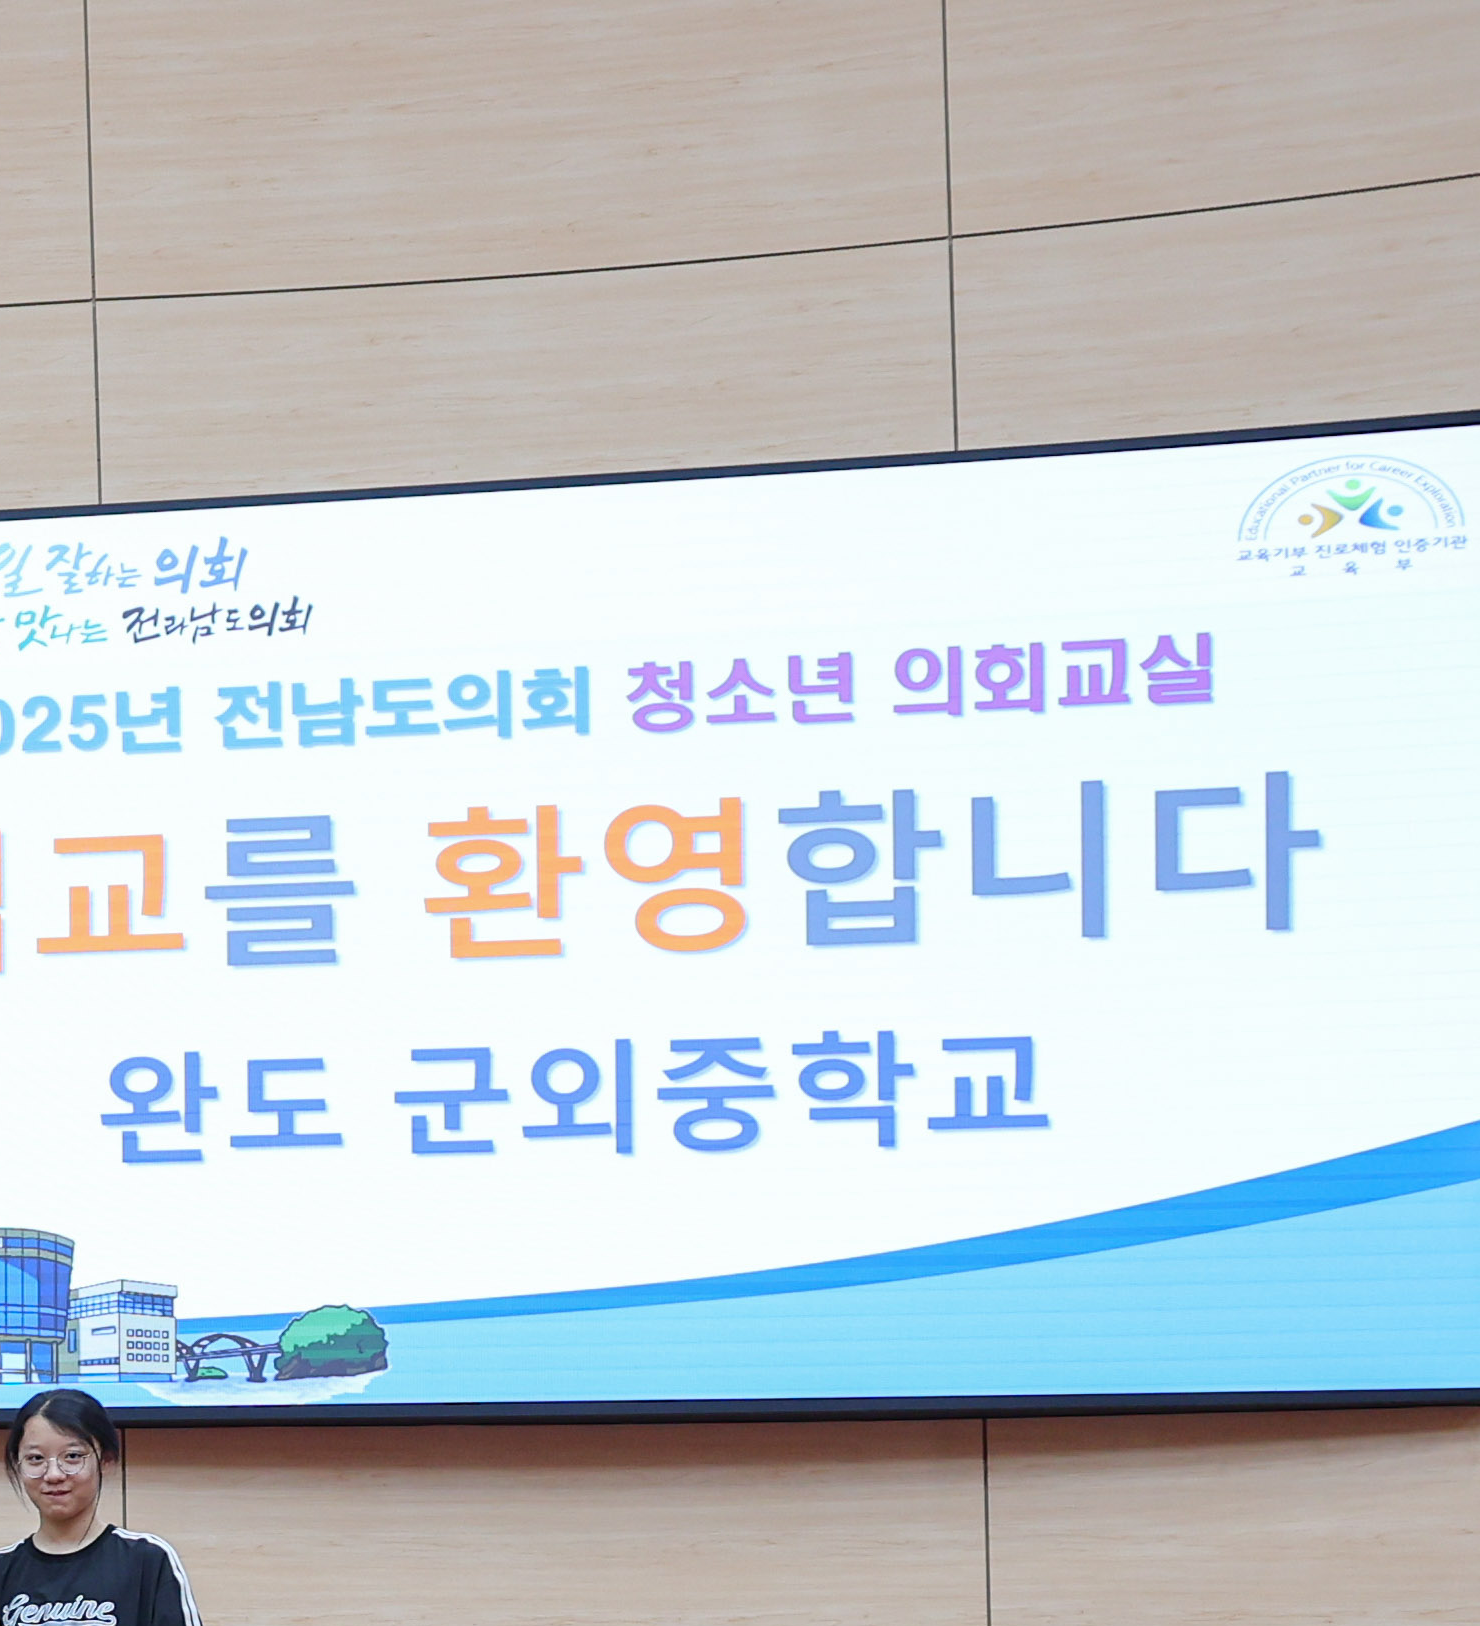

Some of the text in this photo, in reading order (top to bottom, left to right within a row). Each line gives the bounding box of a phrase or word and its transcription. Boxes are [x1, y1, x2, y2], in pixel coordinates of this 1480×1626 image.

[1245, 460, 1457, 541] Educational Partner for Career Exploration
[46, 542, 142, 595] 잘하는
[154, 536, 248, 594] 의회
[1236, 535, 1468, 562] 교육기부 진로체험 인증기관
[15, 605, 108, 652] 맛나는
[122, 592, 314, 645] 전라남도의회
[214, 665, 591, 750] 전남도의회
[626, 651, 856, 734] 청소년
[893, 632, 1215, 718] 의회교실
[424, 770, 1325, 961] 환영합니다
[100, 1030, 1053, 1166] 완도 군외중학교
